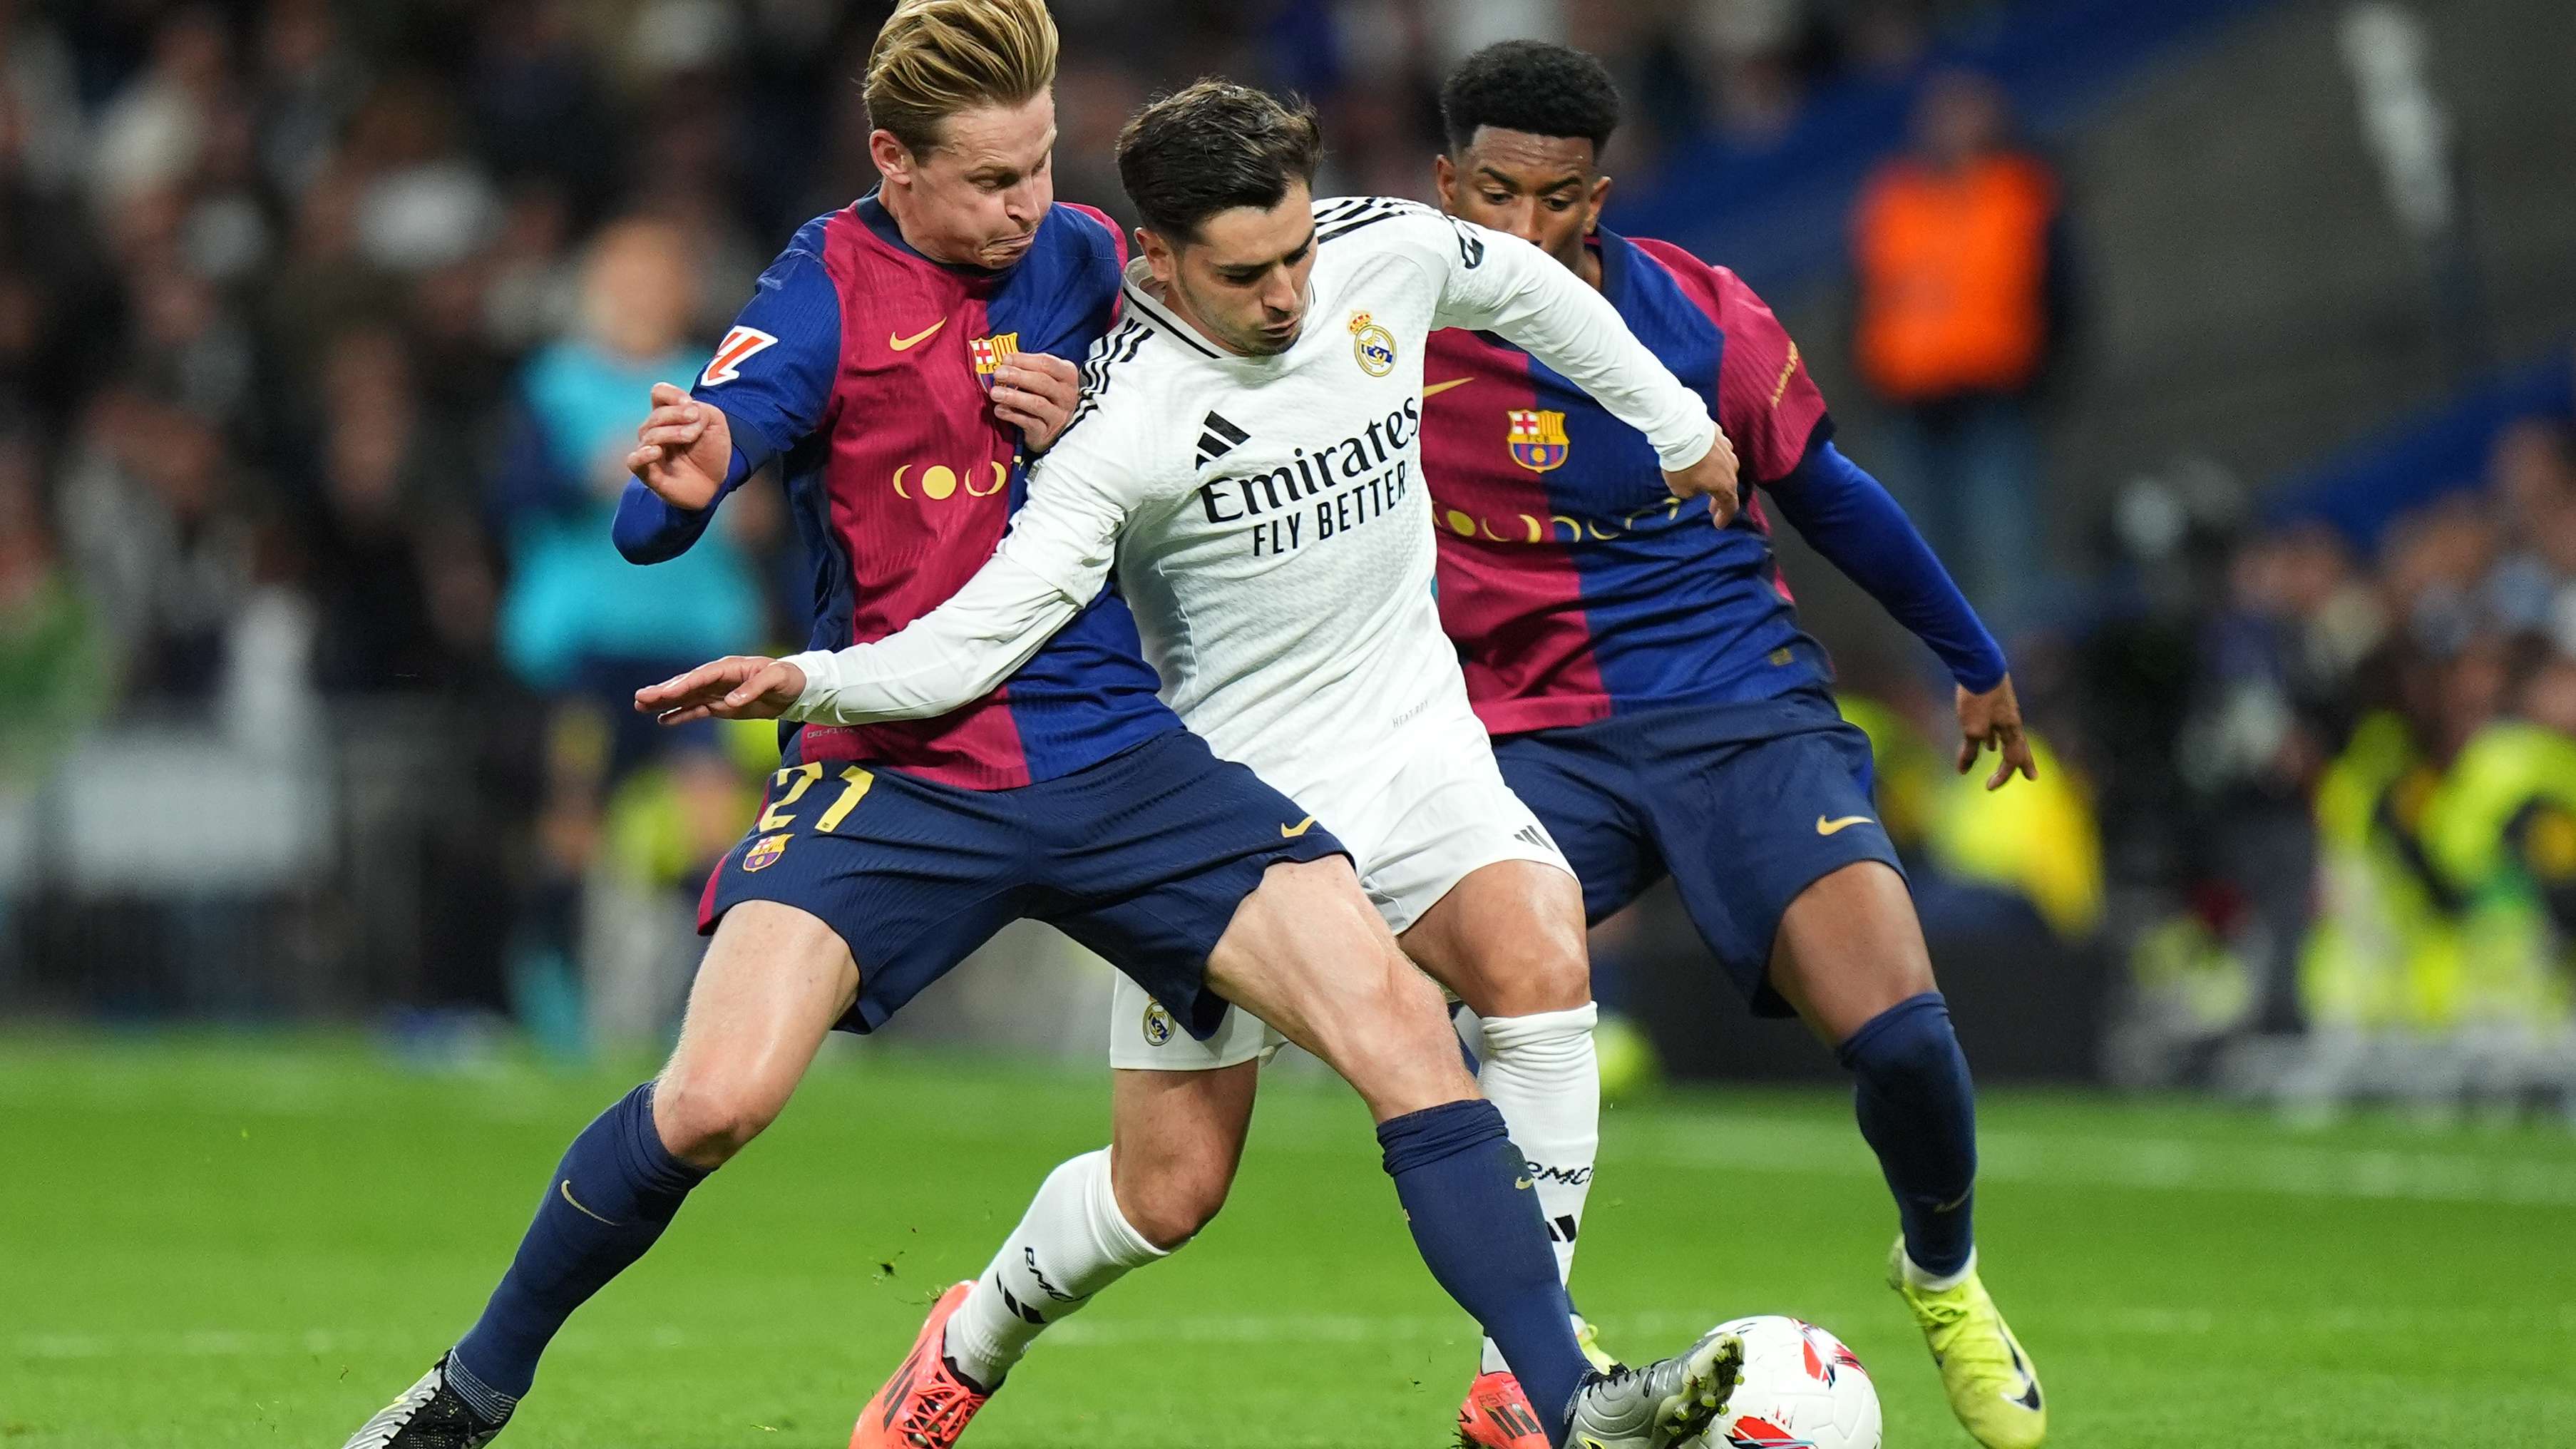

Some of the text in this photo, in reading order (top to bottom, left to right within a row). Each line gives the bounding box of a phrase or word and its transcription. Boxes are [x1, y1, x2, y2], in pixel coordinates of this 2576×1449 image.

[1199, 396, 1418, 524] Emirates
[1253, 511, 1301, 556] FLY
[1317, 460, 1406, 541] BETTER
[759, 761, 875, 833] 21
